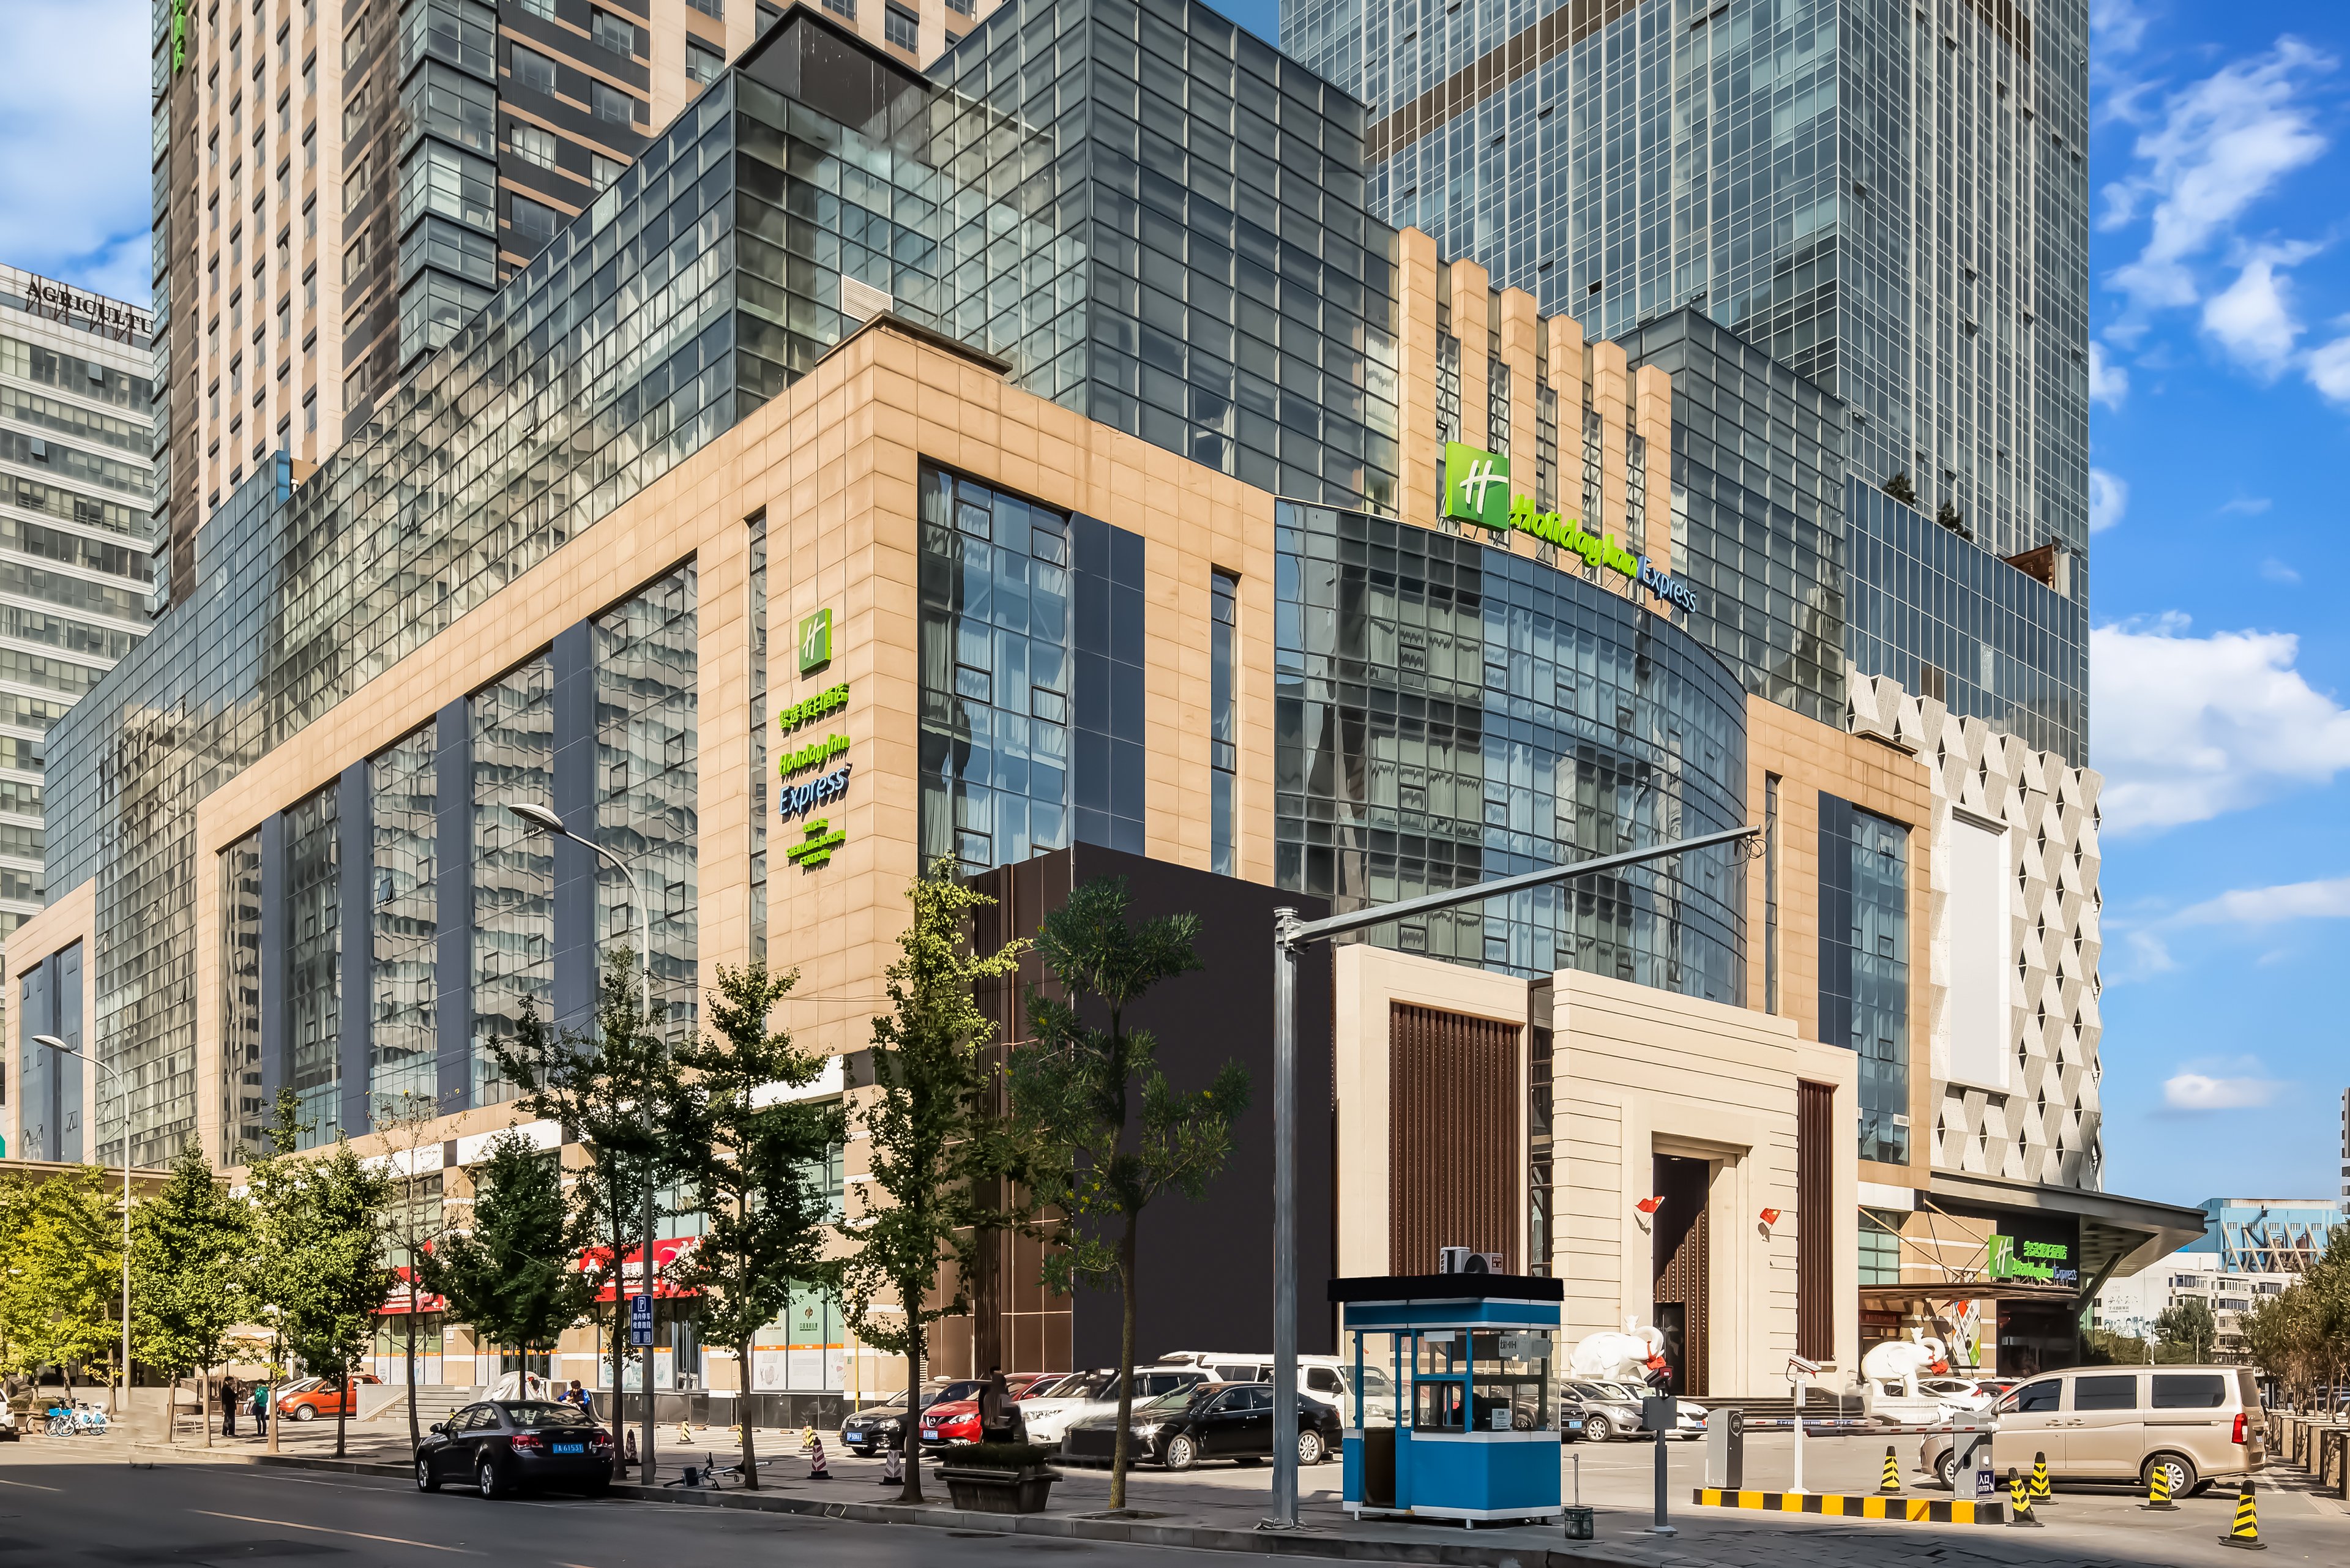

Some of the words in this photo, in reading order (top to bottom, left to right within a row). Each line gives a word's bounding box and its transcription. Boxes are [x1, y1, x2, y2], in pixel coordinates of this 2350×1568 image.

[1509, 494, 1603, 567] Holiday
[1603, 534, 1638, 579] Inn
[1639, 555, 1697, 613] Express
[779, 683, 849, 728] 智选假日酒店
[778, 743, 827, 775] Holiday
[826, 734, 849, 756] Inn
[779, 767, 848, 815] Express
[800, 849, 830, 866] STATION
[1979, 1474, 1989, 1485] 入口
